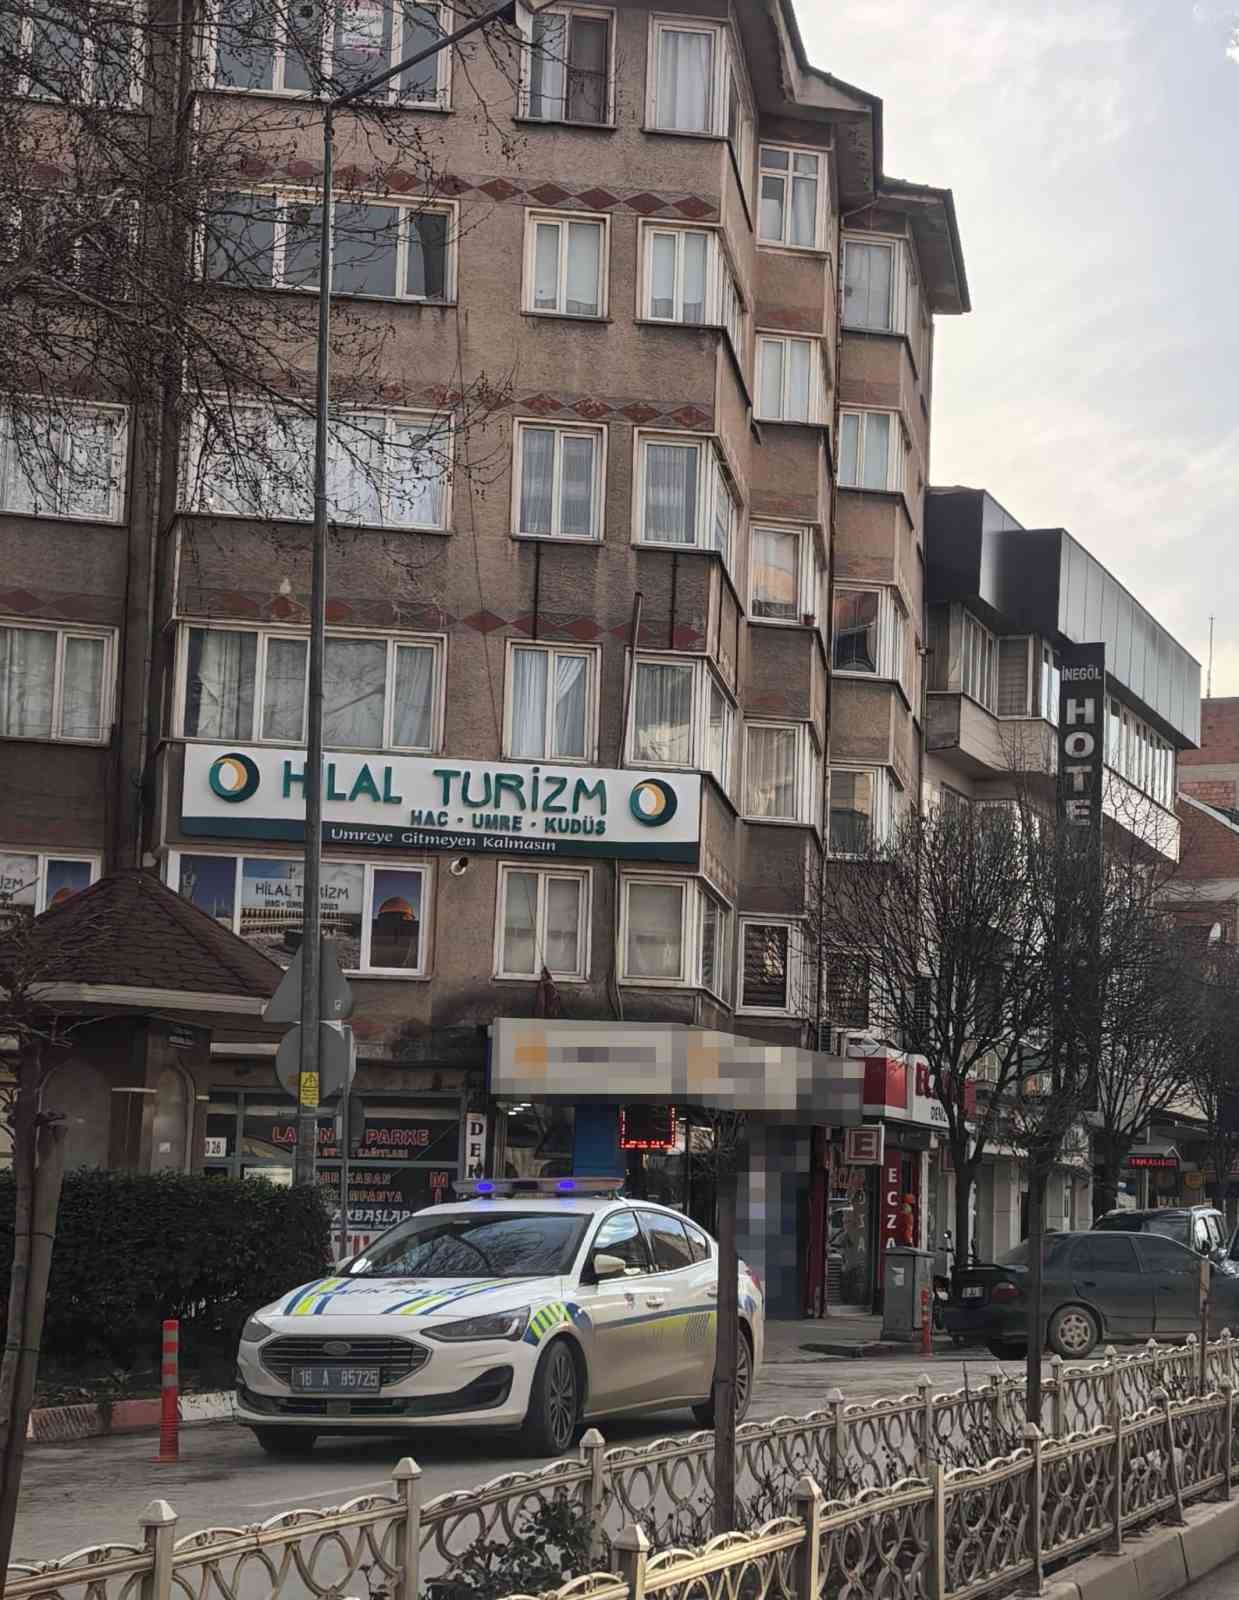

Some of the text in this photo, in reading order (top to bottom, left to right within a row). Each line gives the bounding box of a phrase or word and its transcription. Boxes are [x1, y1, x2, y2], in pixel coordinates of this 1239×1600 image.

[433, 766, 607, 816] TURİZM
[410, 809, 606, 836] HAC UMRE KUDÜS
[331, 827, 557, 852] Umreye Gitmeyen Kalmasın
[322, 1368, 330, 1386] A
